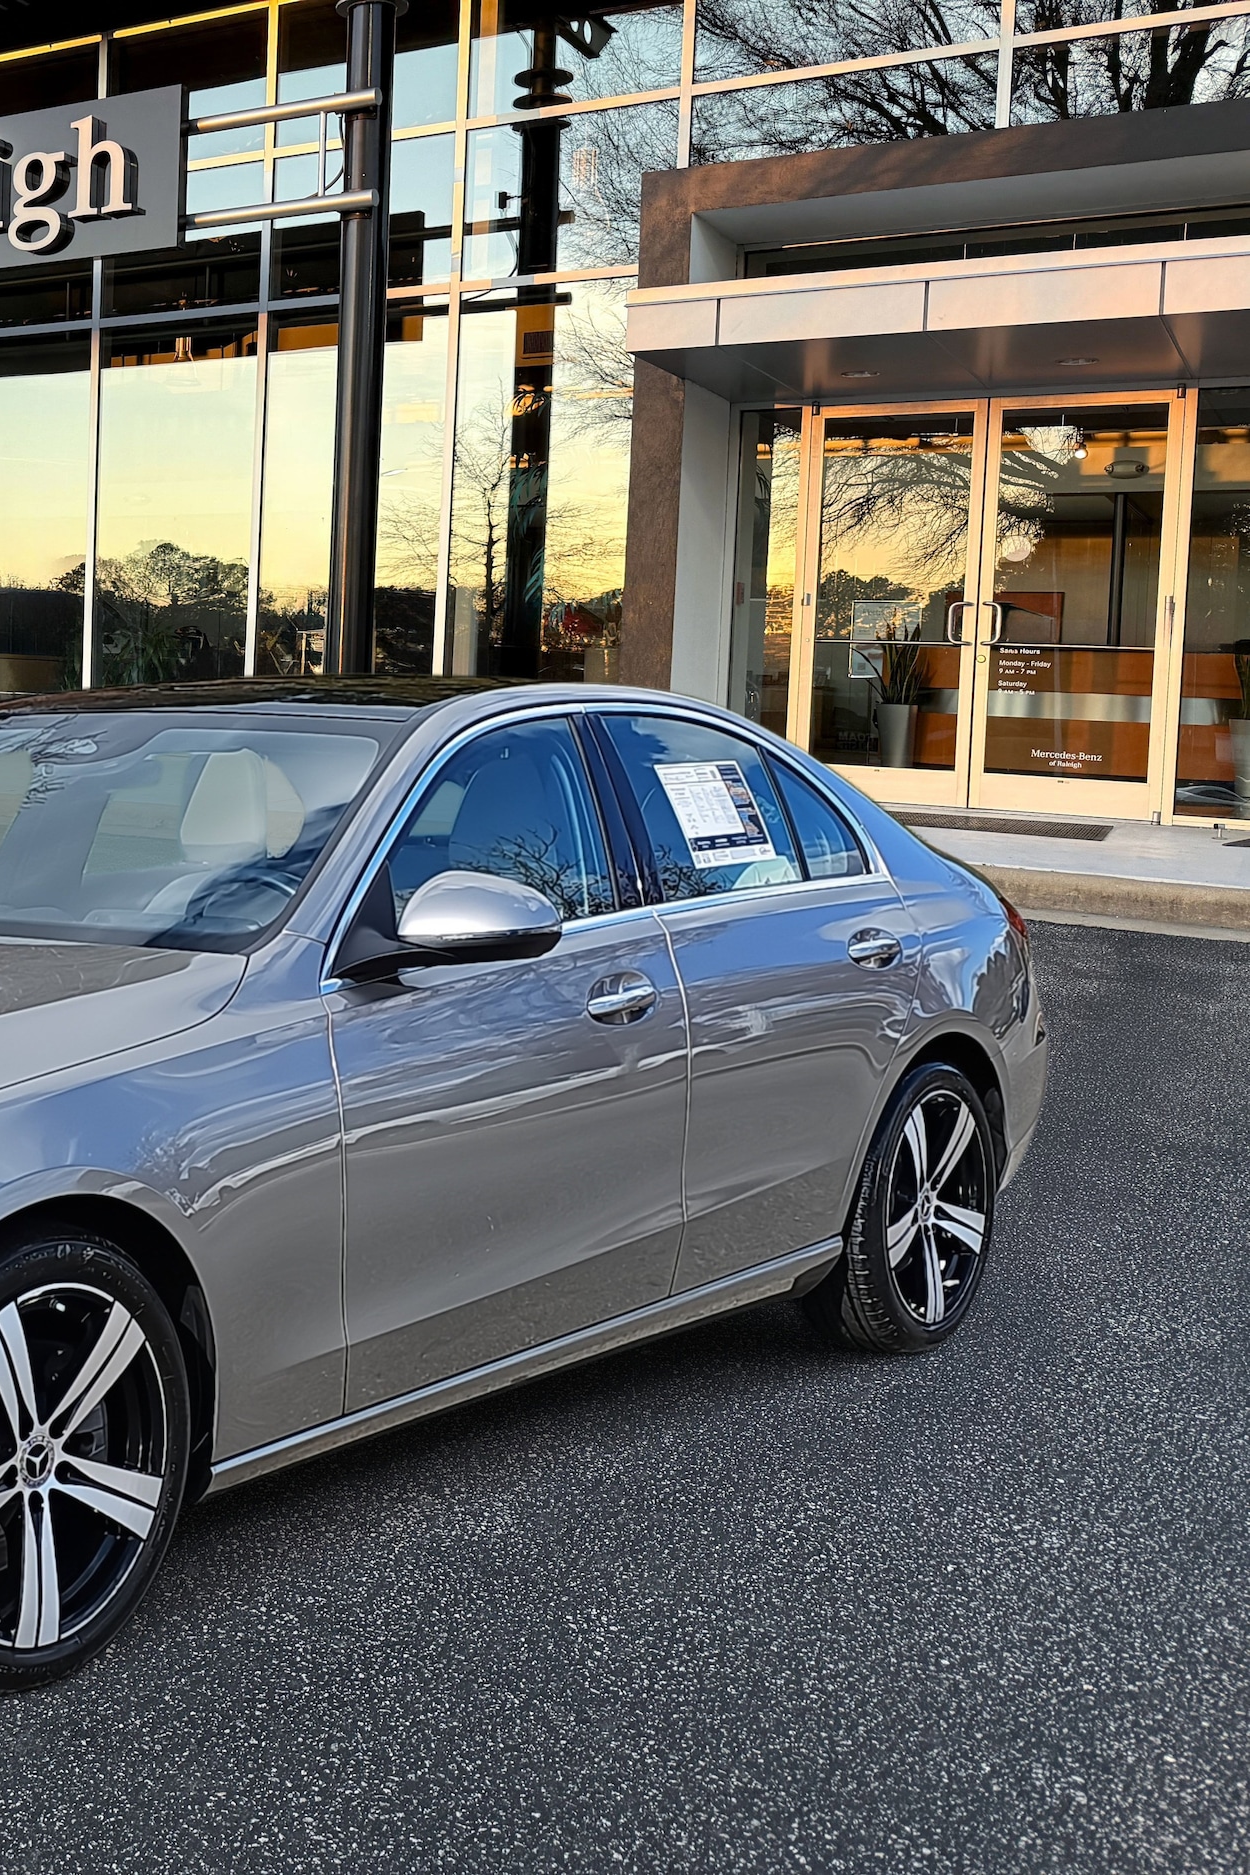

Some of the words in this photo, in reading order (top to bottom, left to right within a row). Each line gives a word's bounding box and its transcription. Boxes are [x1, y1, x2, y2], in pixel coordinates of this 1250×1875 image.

[998, 680, 1027, 688] Saturday
[1031, 749, 1102, 761] Mercedes-Benz
[1057, 761, 1083, 769] Raleigh
